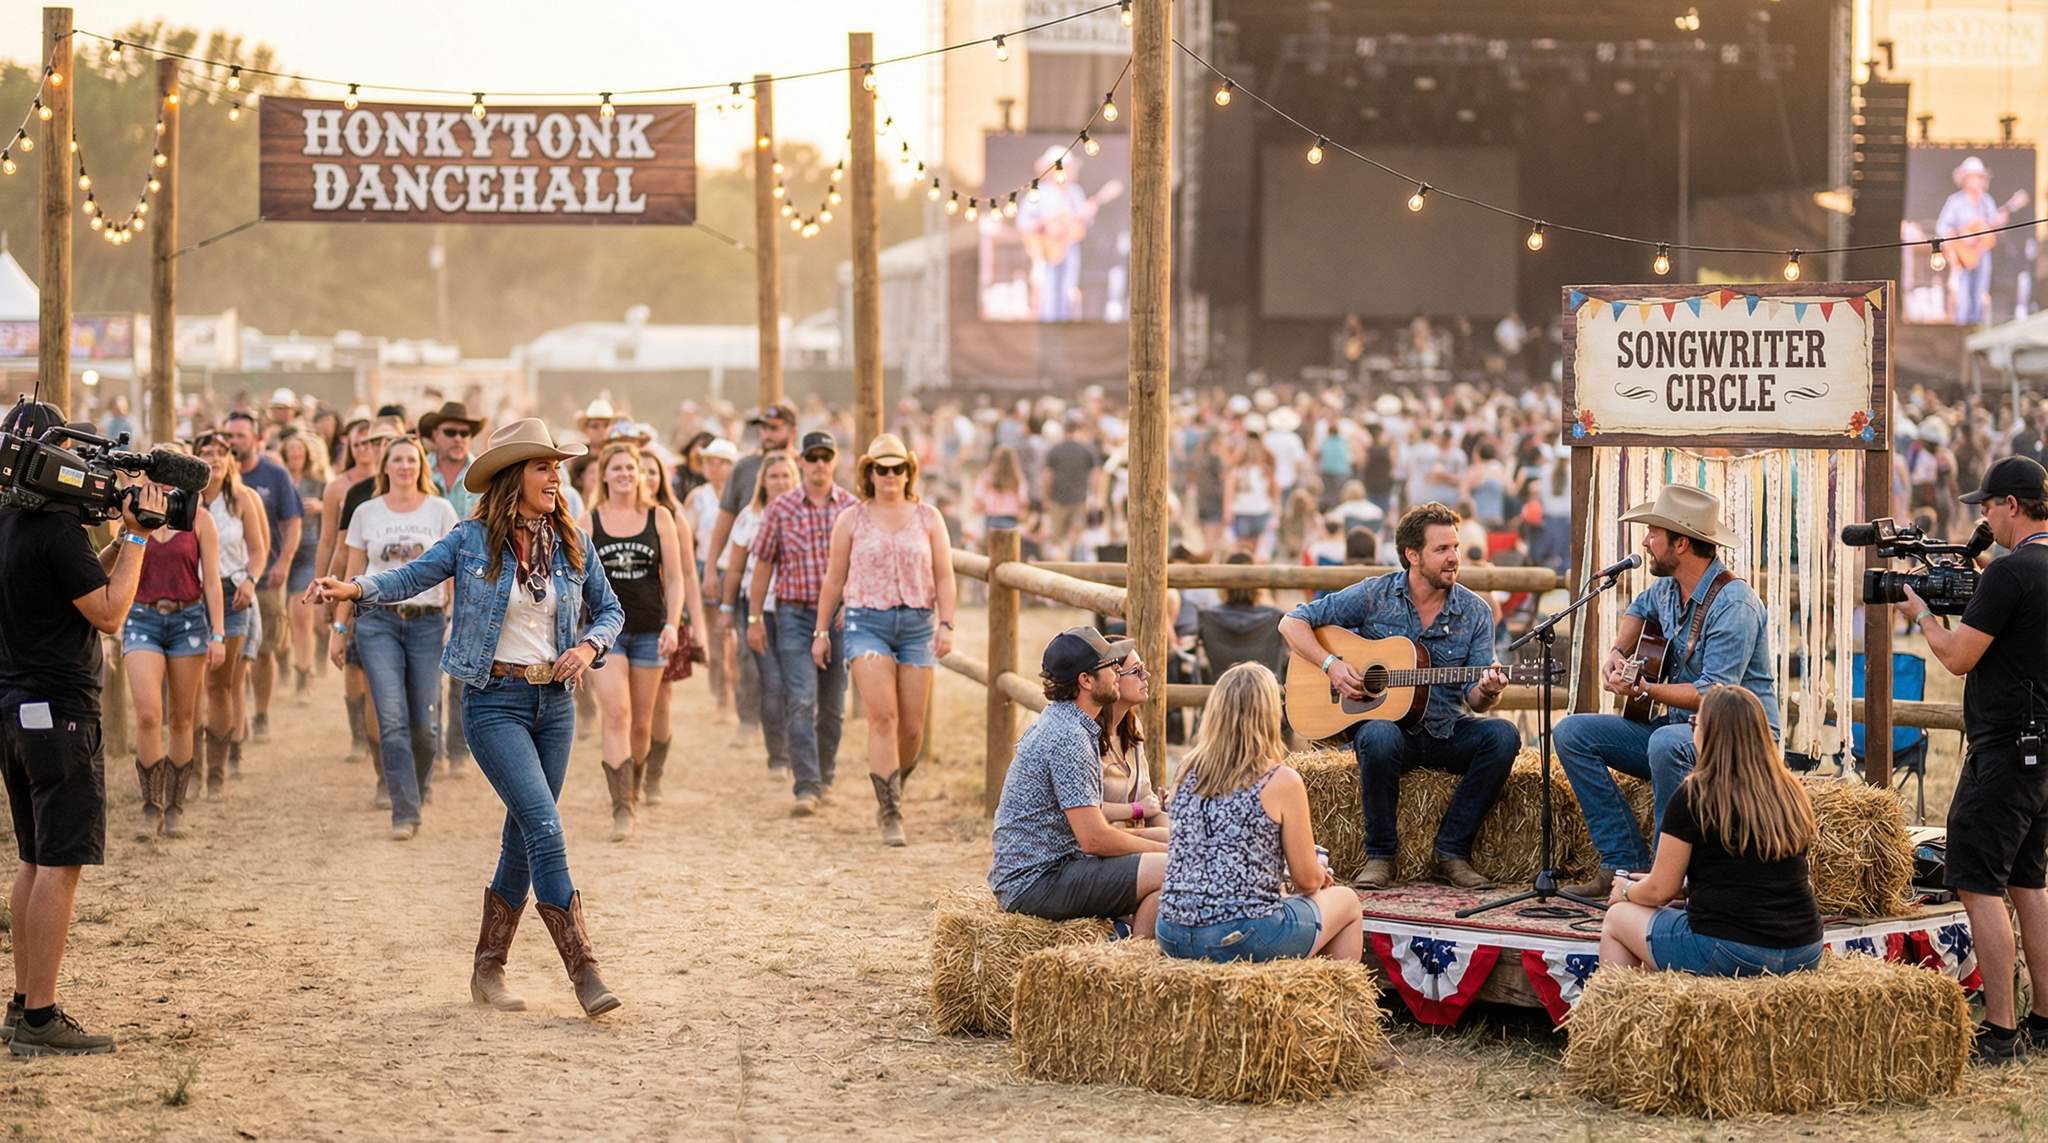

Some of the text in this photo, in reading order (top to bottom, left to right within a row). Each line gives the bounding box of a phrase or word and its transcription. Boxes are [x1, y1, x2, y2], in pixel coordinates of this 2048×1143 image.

[302, 109, 656, 159] HONKYTONK
[312, 163, 646, 213] DANCEHALL
[1617, 329, 1827, 369] SONGWRITER
[1666, 373, 1776, 412] CIRCLE
